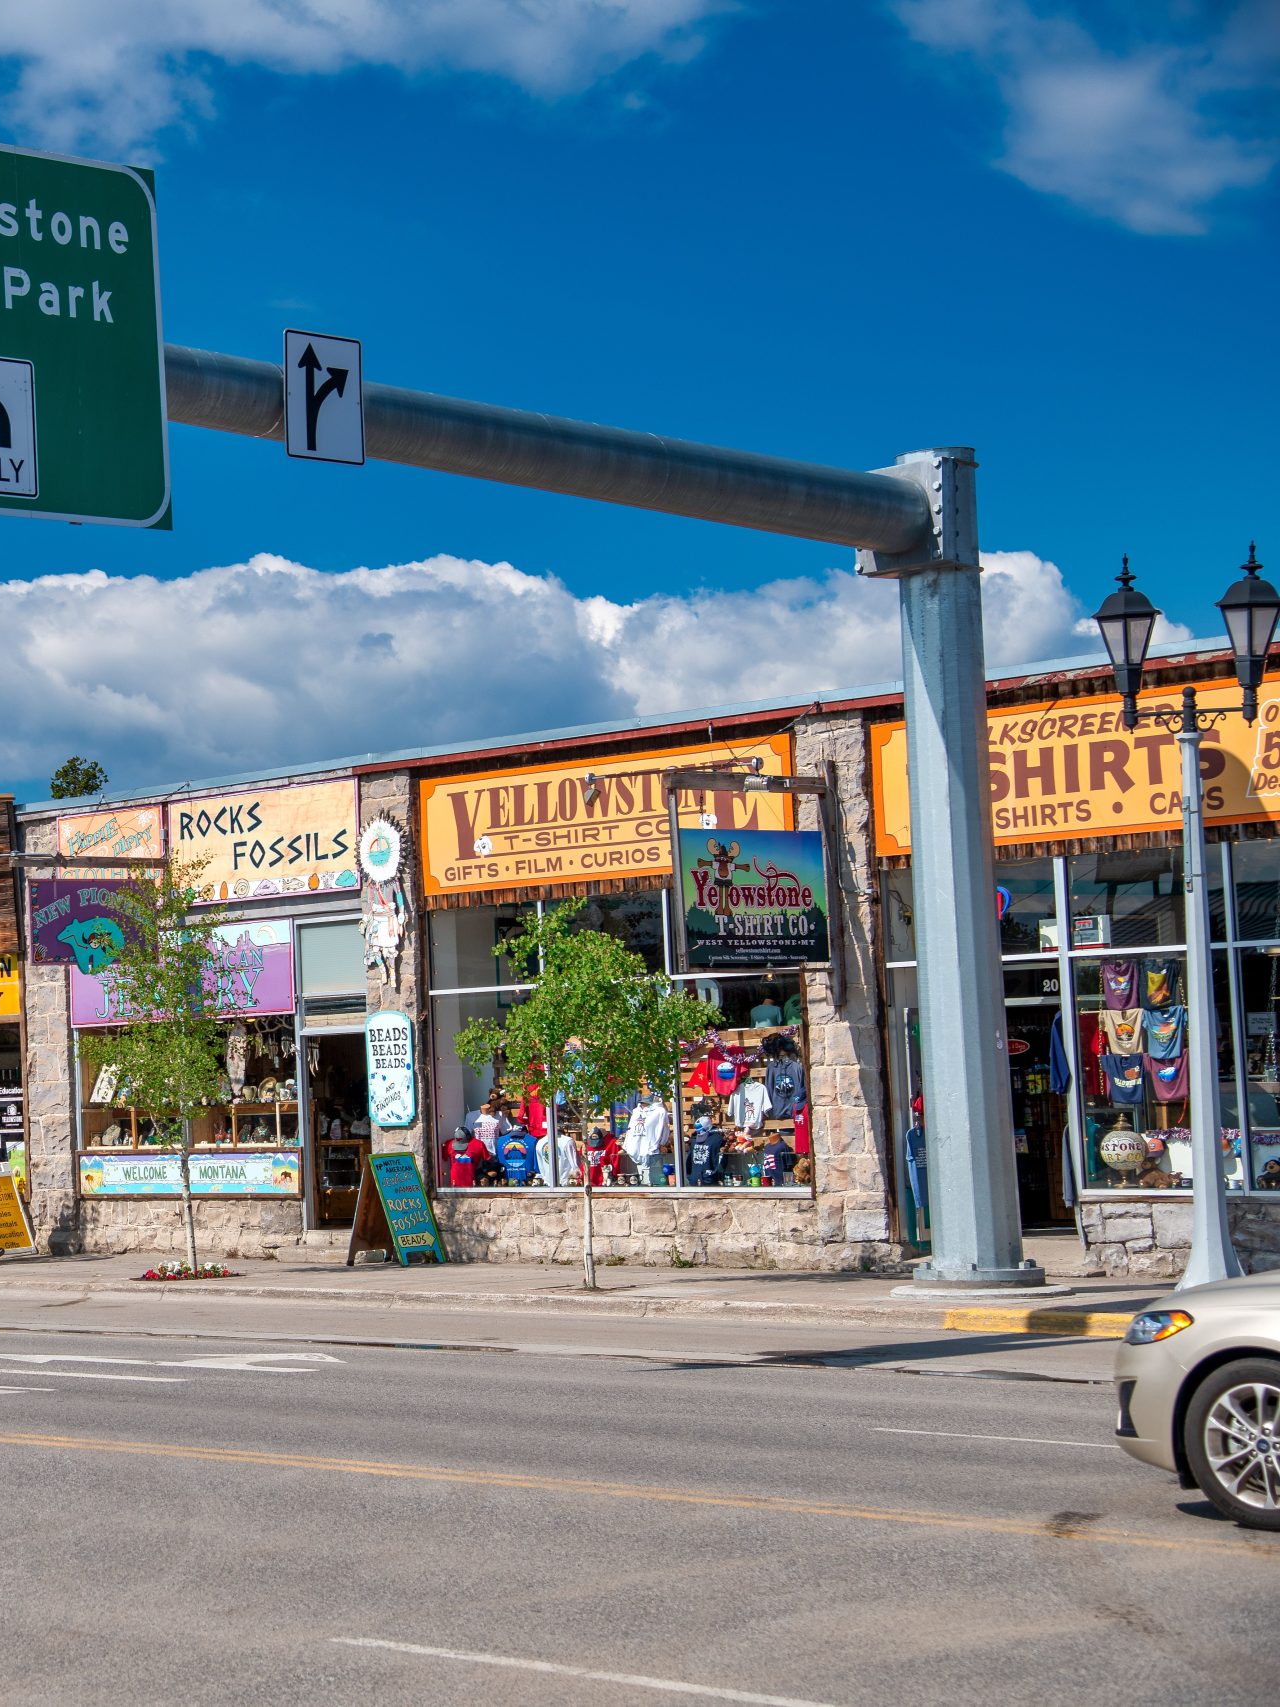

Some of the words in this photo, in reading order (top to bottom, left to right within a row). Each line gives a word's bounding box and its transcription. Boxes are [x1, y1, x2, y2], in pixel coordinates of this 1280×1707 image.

[4, 266, 115, 323] Park
[987, 702, 1176, 746] LKSCREEED
[989, 728, 1226, 803] SHIRTS
[1149, 786, 1225, 816] CAS
[179, 801, 263, 841] ROCKS
[112, 823, 153, 858] DIPPY
[232, 828, 349, 870] FOSSILS
[504, 824, 620, 850] T-SHIRT
[444, 862, 499, 882] GIFTS
[515, 856, 563, 876] FILM
[580, 847, 661, 869] CURIOS
[33, 895, 71, 929] NEW
[715, 914, 784, 936] T-SHIRT
[369, 1027, 408, 1043] BEADS
[372, 1043, 408, 1057] BEADS
[375, 1058, 406, 1069] BEADS
[122, 1165, 168, 1181] WELCOME
[199, 1164, 247, 1180] MONTANA
[386, 1197, 422, 1212] ROCKS
[392, 1209, 429, 1232] FOSSILS
[4, 1241, 20, 1249] Gifts
[400, 1234, 428, 1246] BEADS
